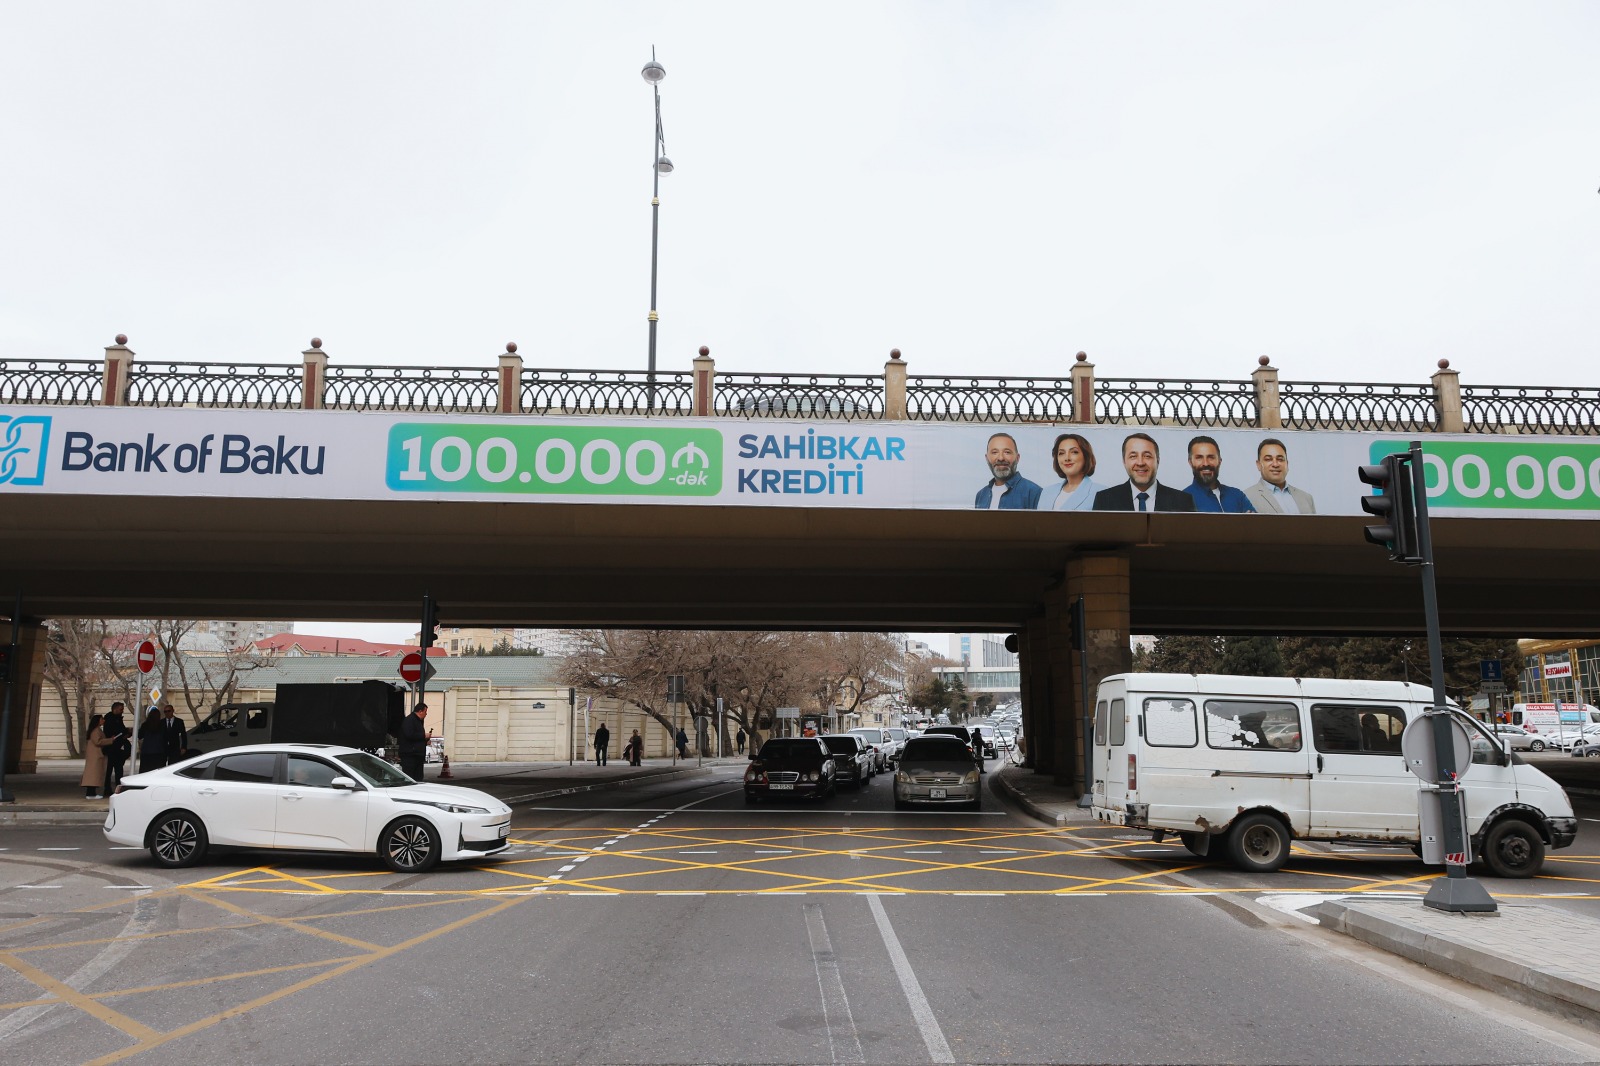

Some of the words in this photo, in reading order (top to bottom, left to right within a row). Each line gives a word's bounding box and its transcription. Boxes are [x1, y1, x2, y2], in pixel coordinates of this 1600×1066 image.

[61, 431, 170, 473] Bank
[173, 433, 214, 474] of
[219, 434, 326, 476] Baku
[738, 427, 906, 461] SAHİBKAR
[668, 470, 709, 486] -dək
[737, 462, 864, 495] KREDİTİ
